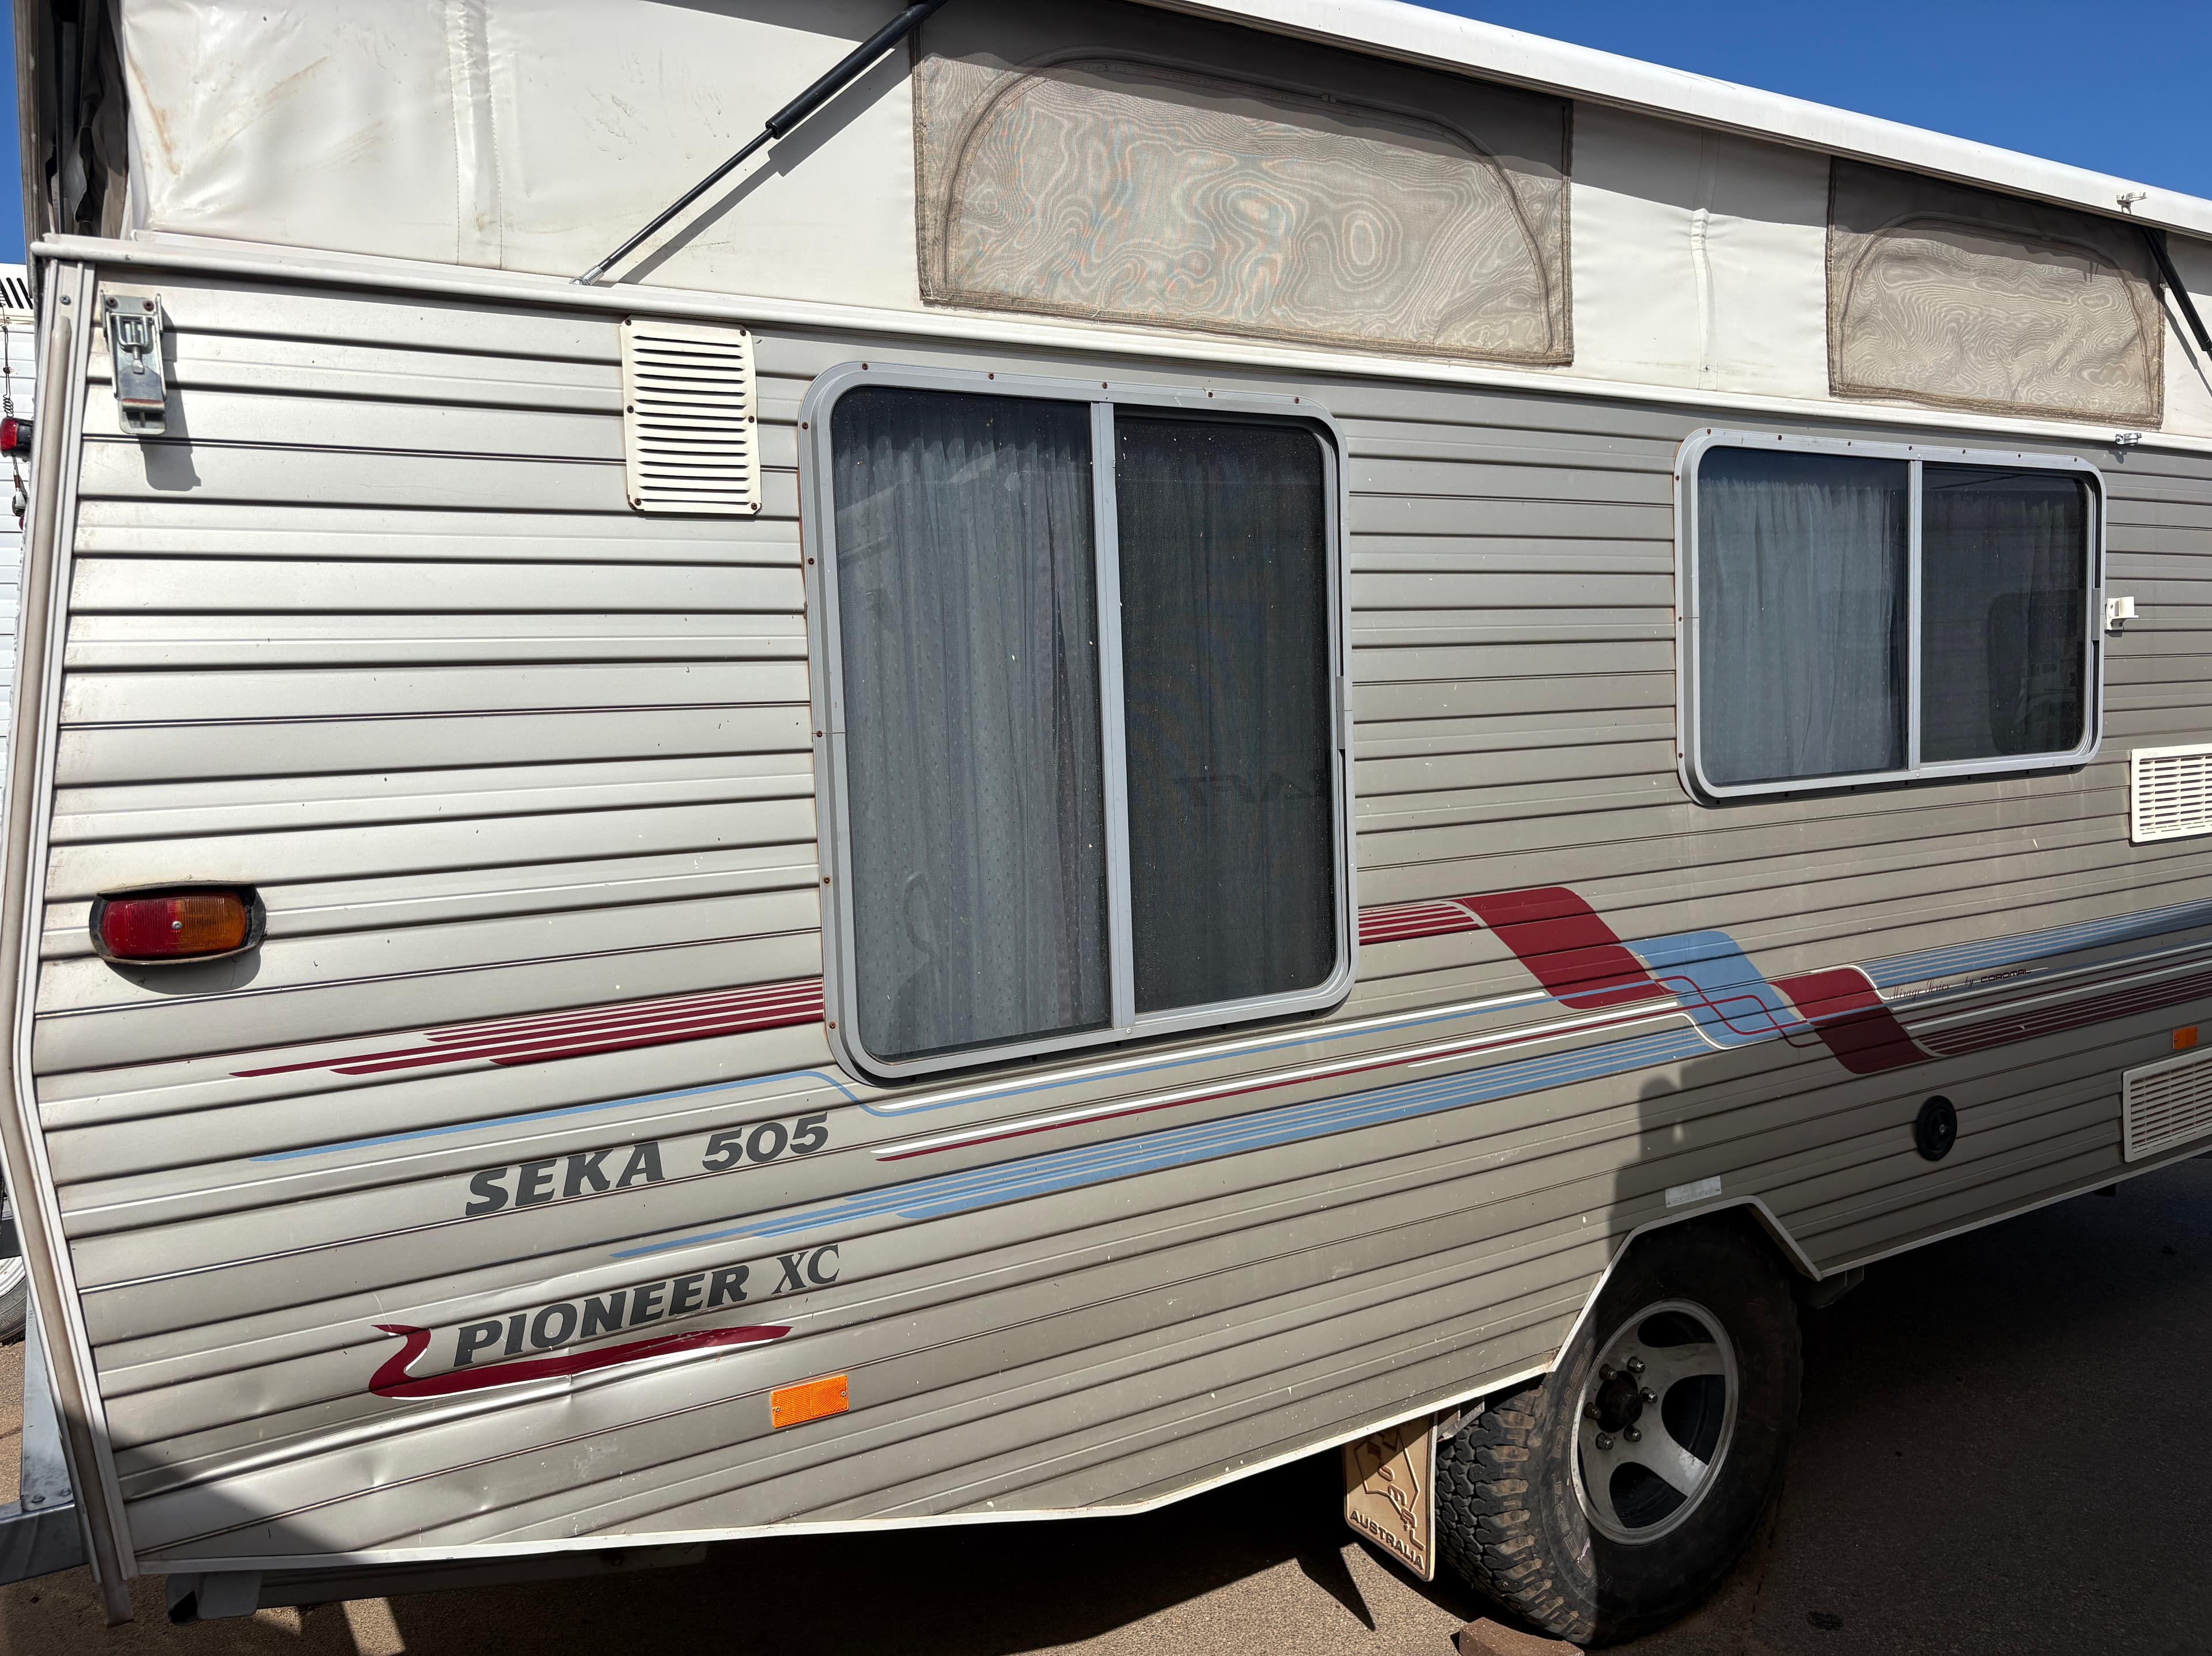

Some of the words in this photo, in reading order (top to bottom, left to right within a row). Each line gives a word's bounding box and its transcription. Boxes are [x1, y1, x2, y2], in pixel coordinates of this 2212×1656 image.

[1889, 986, 1921, 1003] Mirage
[1926, 979, 1950, 994] Series
[1965, 976, 1974, 987] by
[1980, 968, 2032, 983] COROMAL
[465, 1141, 665, 1217] SEKA
[702, 1112, 828, 1172] 505
[453, 1265, 749, 1367] PIONEER
[771, 1244, 840, 1295] XC
[1350, 1509, 1425, 1570] AUSTRALIA
